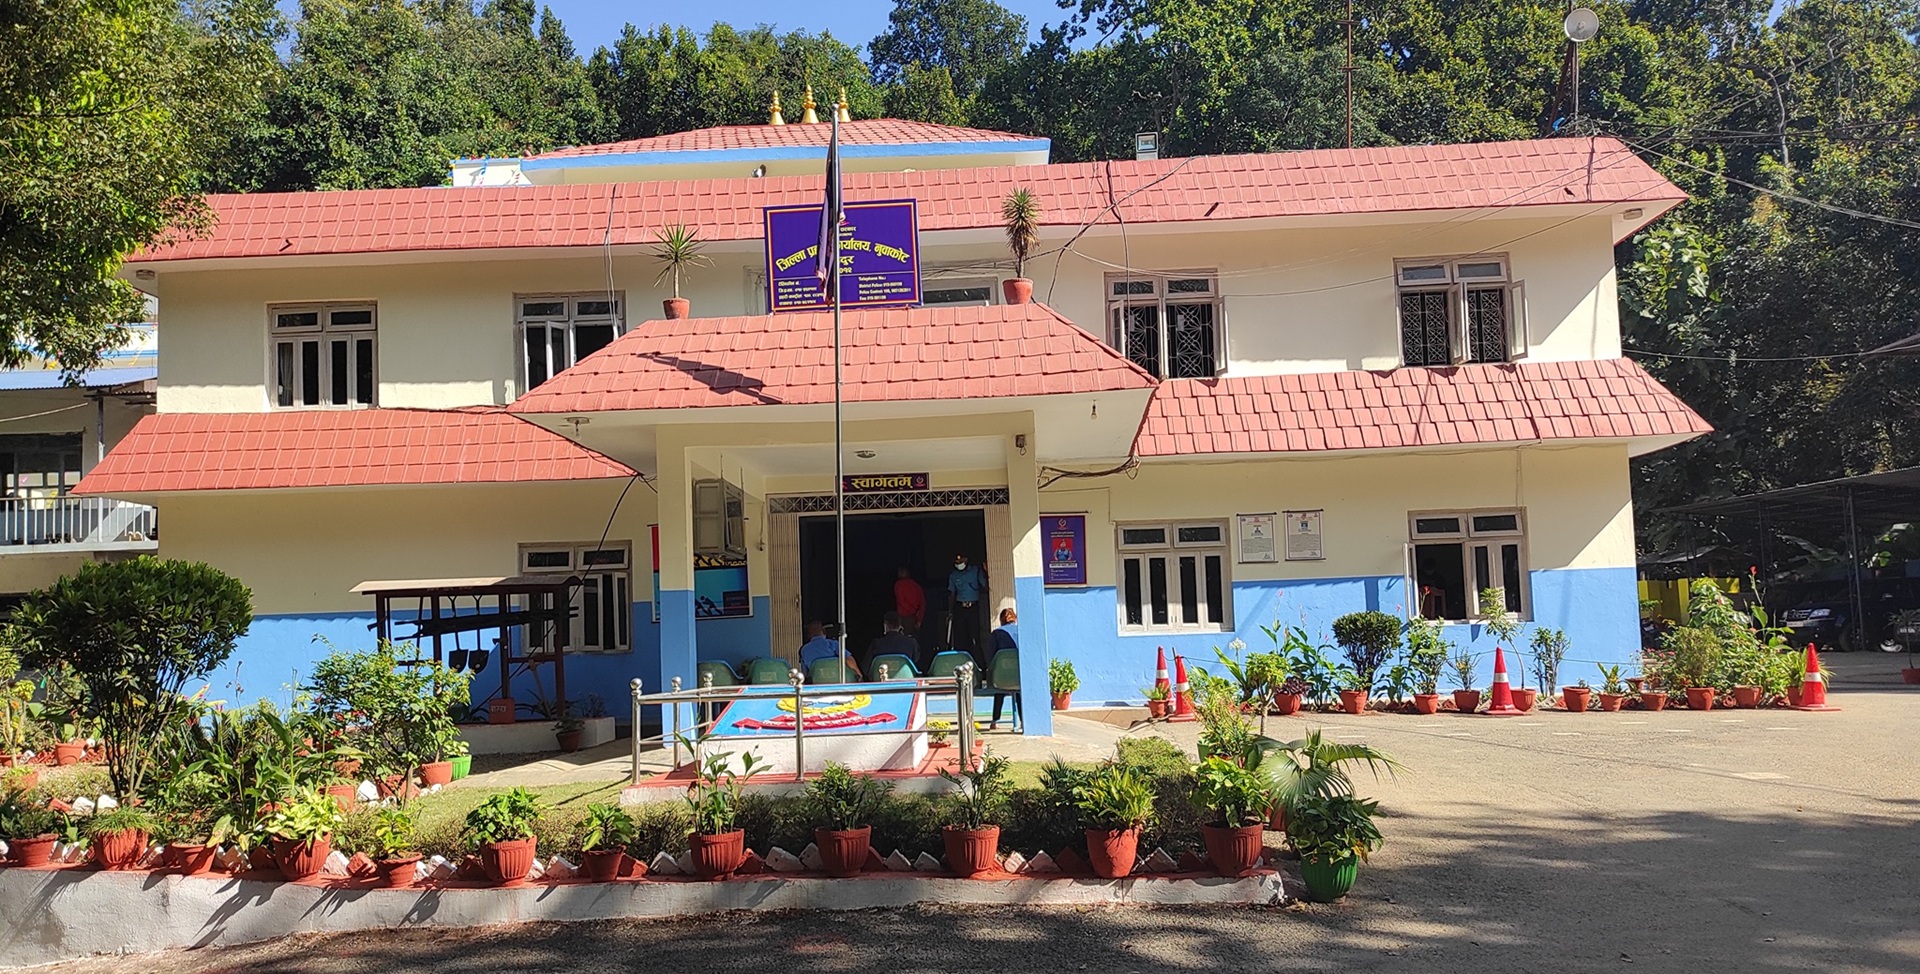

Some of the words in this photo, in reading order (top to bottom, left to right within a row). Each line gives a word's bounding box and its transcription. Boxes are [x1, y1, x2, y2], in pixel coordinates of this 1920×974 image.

[775, 249, 807, 272] जिल्ला
[874, 243, 910, 263] नुवाकोट
[851, 476, 913, 489] स्वागतम्
